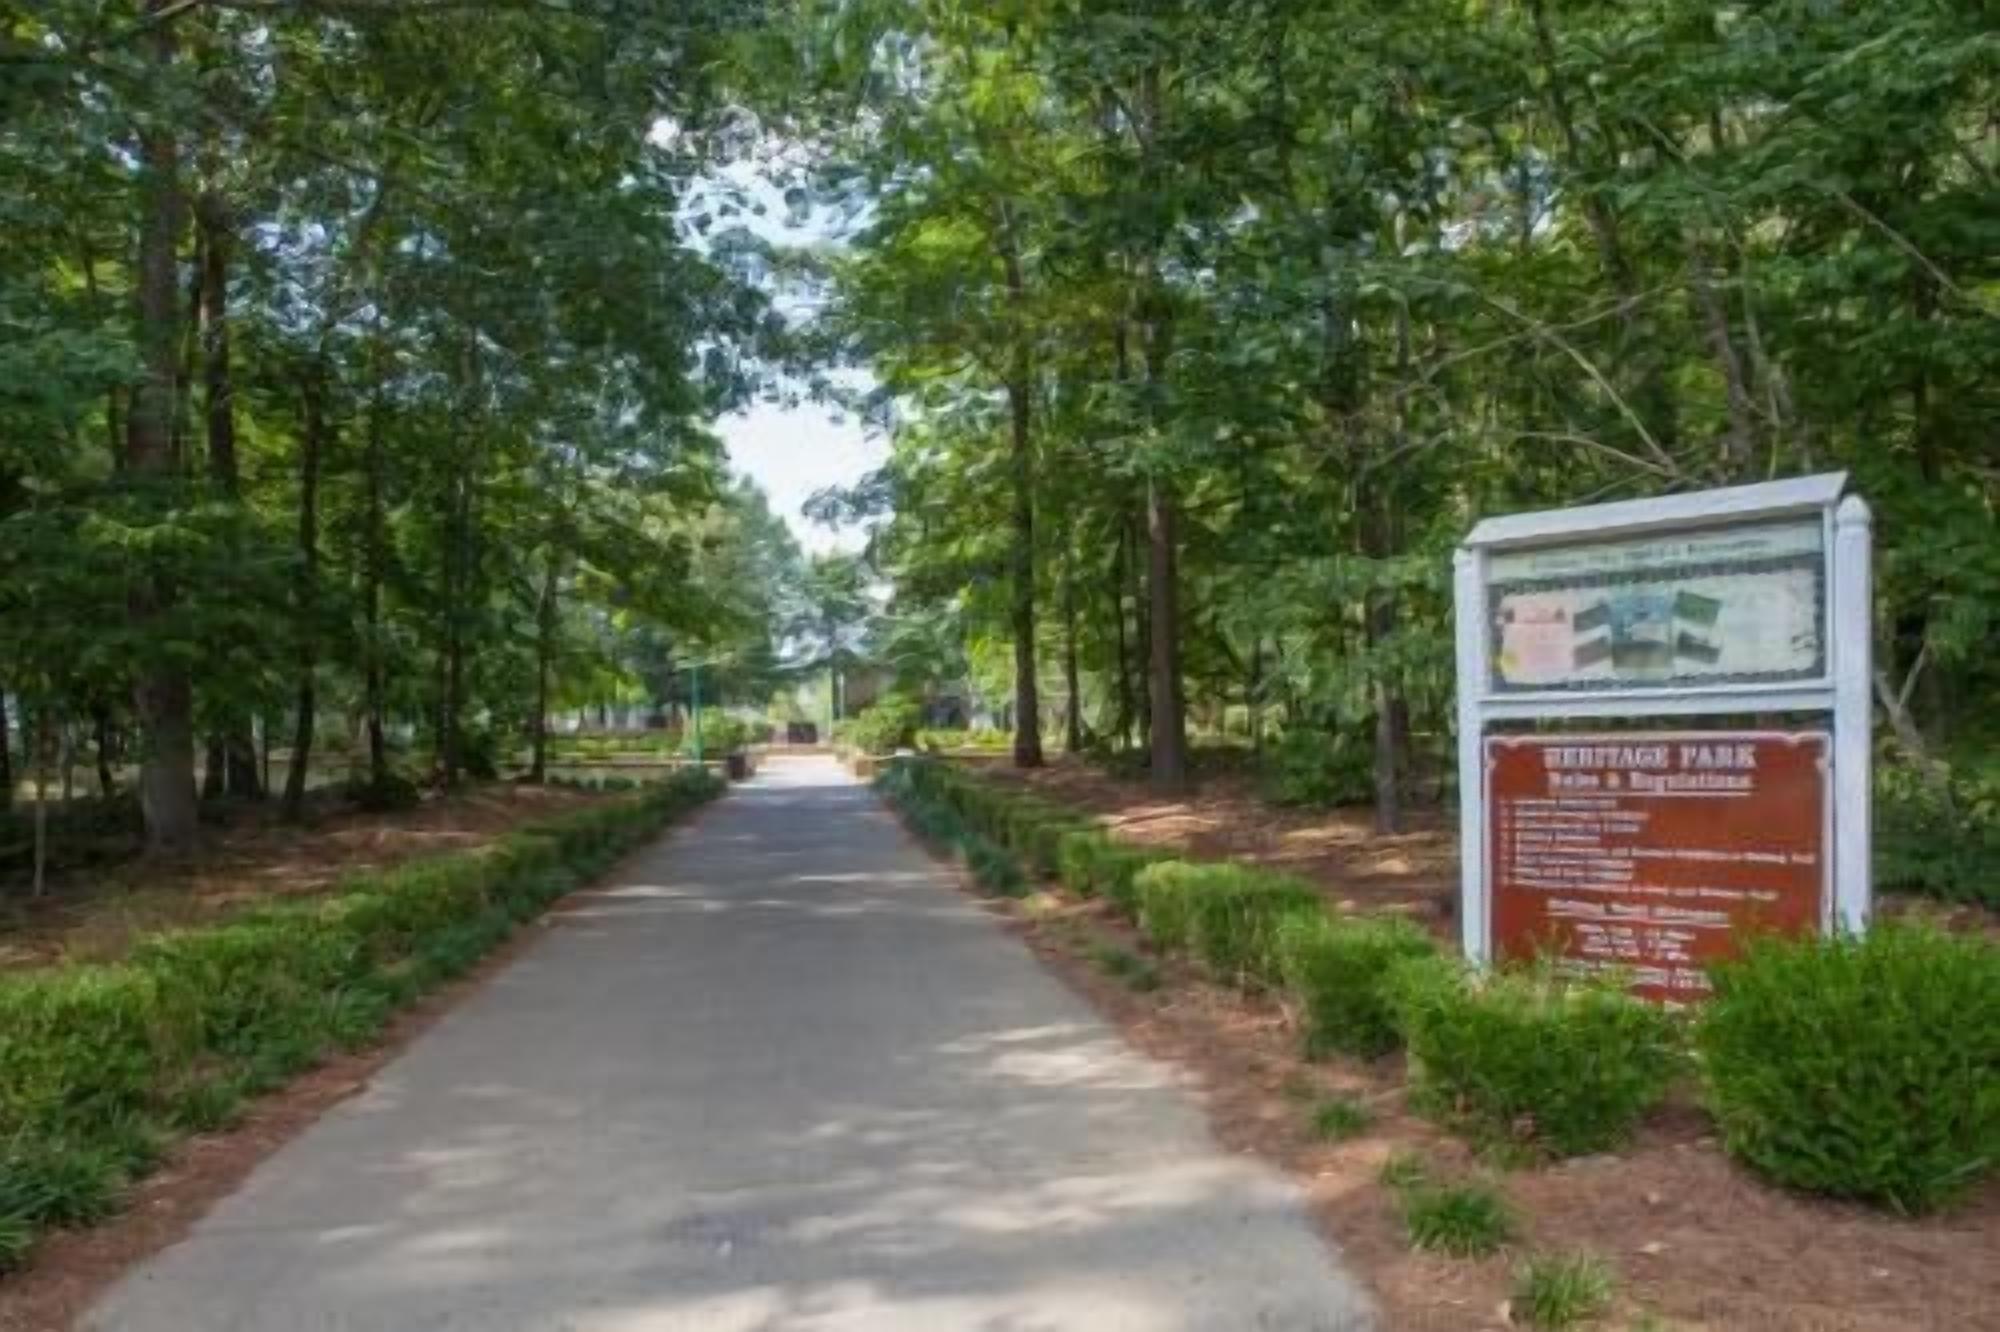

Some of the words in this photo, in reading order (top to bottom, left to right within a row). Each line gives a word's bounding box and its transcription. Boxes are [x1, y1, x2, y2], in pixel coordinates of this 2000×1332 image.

[1545, 746, 1668, 769] HERITAGE
[1681, 745, 1756, 769] PARK
[1630, 772, 1752, 794] Regulations
